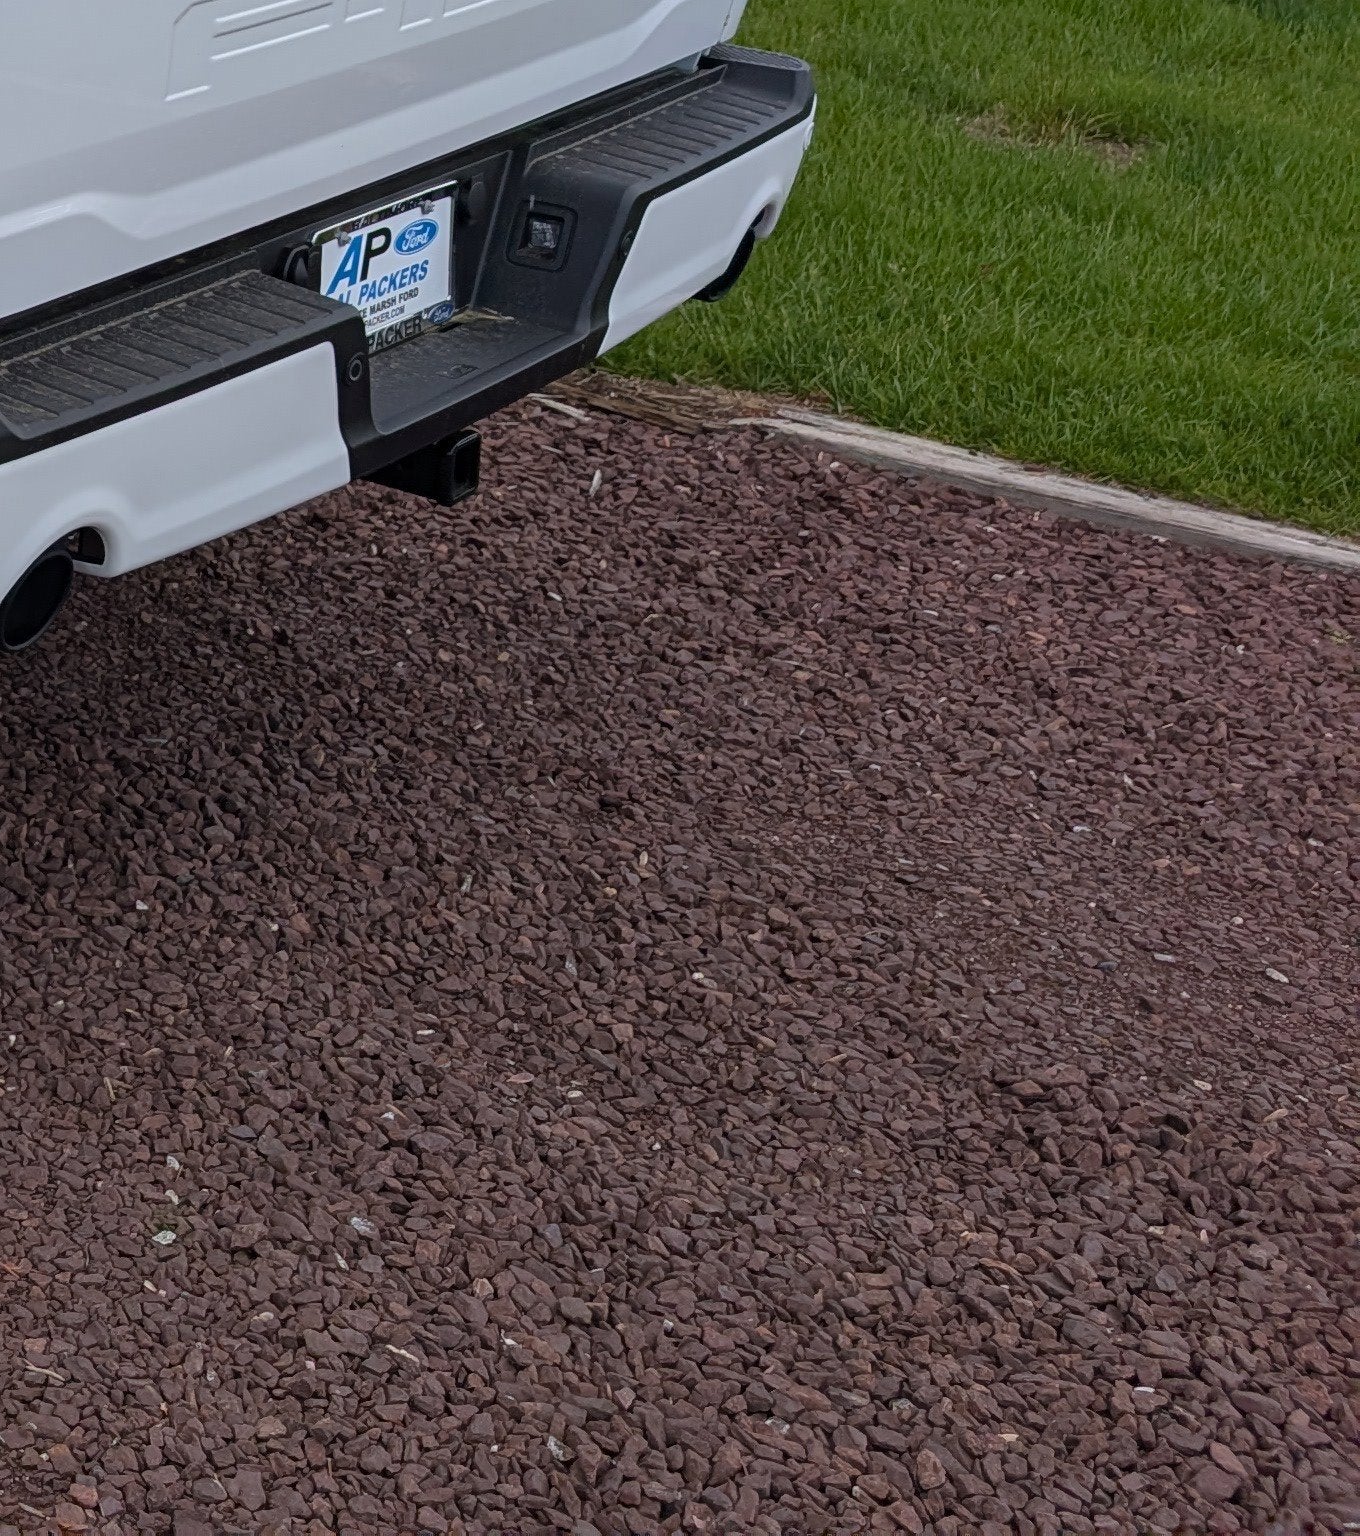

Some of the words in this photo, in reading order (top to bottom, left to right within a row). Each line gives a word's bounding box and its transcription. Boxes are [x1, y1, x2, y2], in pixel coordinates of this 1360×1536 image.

[401, 223, 431, 251] Ford
[325, 227, 392, 296] AP
[358, 259, 429, 306] PACKERS
[369, 296, 397, 315] MARSH
[398, 287, 419, 304] FORD
